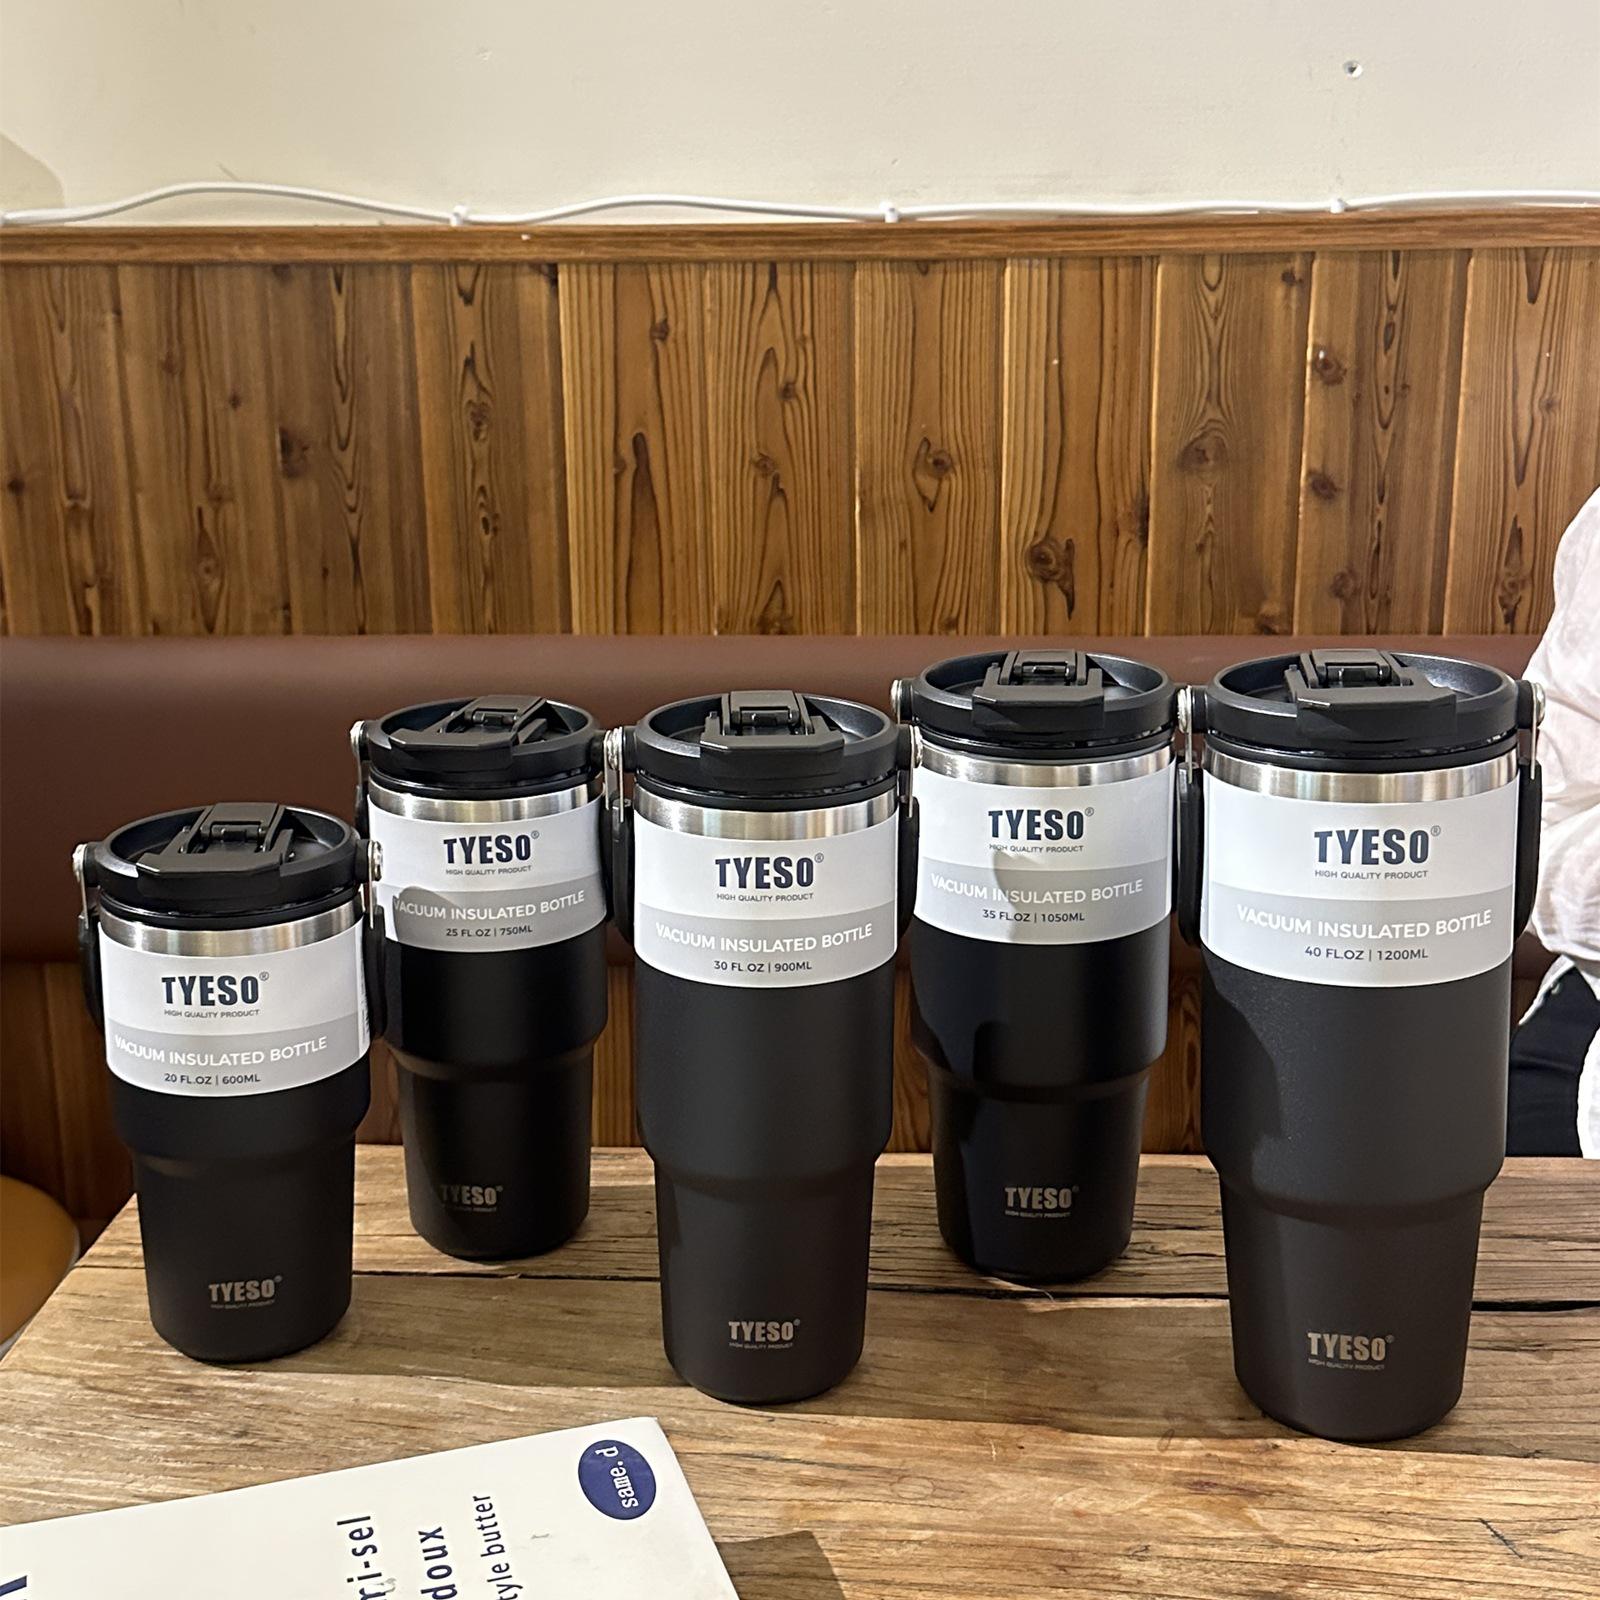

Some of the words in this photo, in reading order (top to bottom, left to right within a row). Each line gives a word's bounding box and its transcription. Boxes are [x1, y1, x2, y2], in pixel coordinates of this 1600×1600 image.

[989, 843, 1008, 851] HIGH
[1010, 845, 1043, 854] QUALITY
[1046, 845, 1084, 853] PRODUCT
[445, 868, 464, 876] HIGH
[465, 868, 496, 877] QUALITY
[498, 865, 532, 875] PRODUCT
[1314, 869, 1338, 879] HIGH
[1340, 871, 1381, 880] QUALITY
[1384, 870, 1429, 880] PRODUCT
[930, 872, 988, 900] VACUUM
[993, 888, 1086, 904] INSULATED
[1091, 879, 1144, 901] BOTTLE
[716, 892, 736, 901] HIGH
[738, 893, 773, 902] QUALITY
[775, 892, 814, 901] PRODUCT
[392, 899, 447, 920] VACUUM
[451, 904, 537, 921] INSULATED
[540, 890, 586, 914] BOTTLE
[982, 908, 996, 919] 35
[1041, 911, 1086, 923] 1050ML
[1236, 904, 1311, 936] VACUUM
[1318, 921, 1430, 939] INSULATED
[1435, 909, 1493, 936] BOTTLE
[446, 927, 459, 937] 25
[500, 925, 533, 936] 750ML
[655, 921, 715, 950] VACUUM
[720, 937, 817, 953] INSULATED
[821, 922, 873, 949] BOTTLE
[1304, 946, 1322, 958] 40
[1377, 948, 1429, 961] 1200ML
[714, 960, 728, 970] 30
[775, 960, 813, 972] 900ML
[164, 1009, 183, 1018] HIGH
[184, 1010, 219, 1019] QUALITY
[220, 1009, 260, 1018] PRODUCT
[114, 1034, 165, 1063] VACUUM
[169, 1050, 265, 1067] INSULATED
[270, 1035, 328, 1062] BOTTLE
[164, 1073, 178, 1084] 20
[222, 1073, 262, 1085] 600ML
[472, 1495, 505, 1558] butter
[418, 1526, 458, 1600] doux
